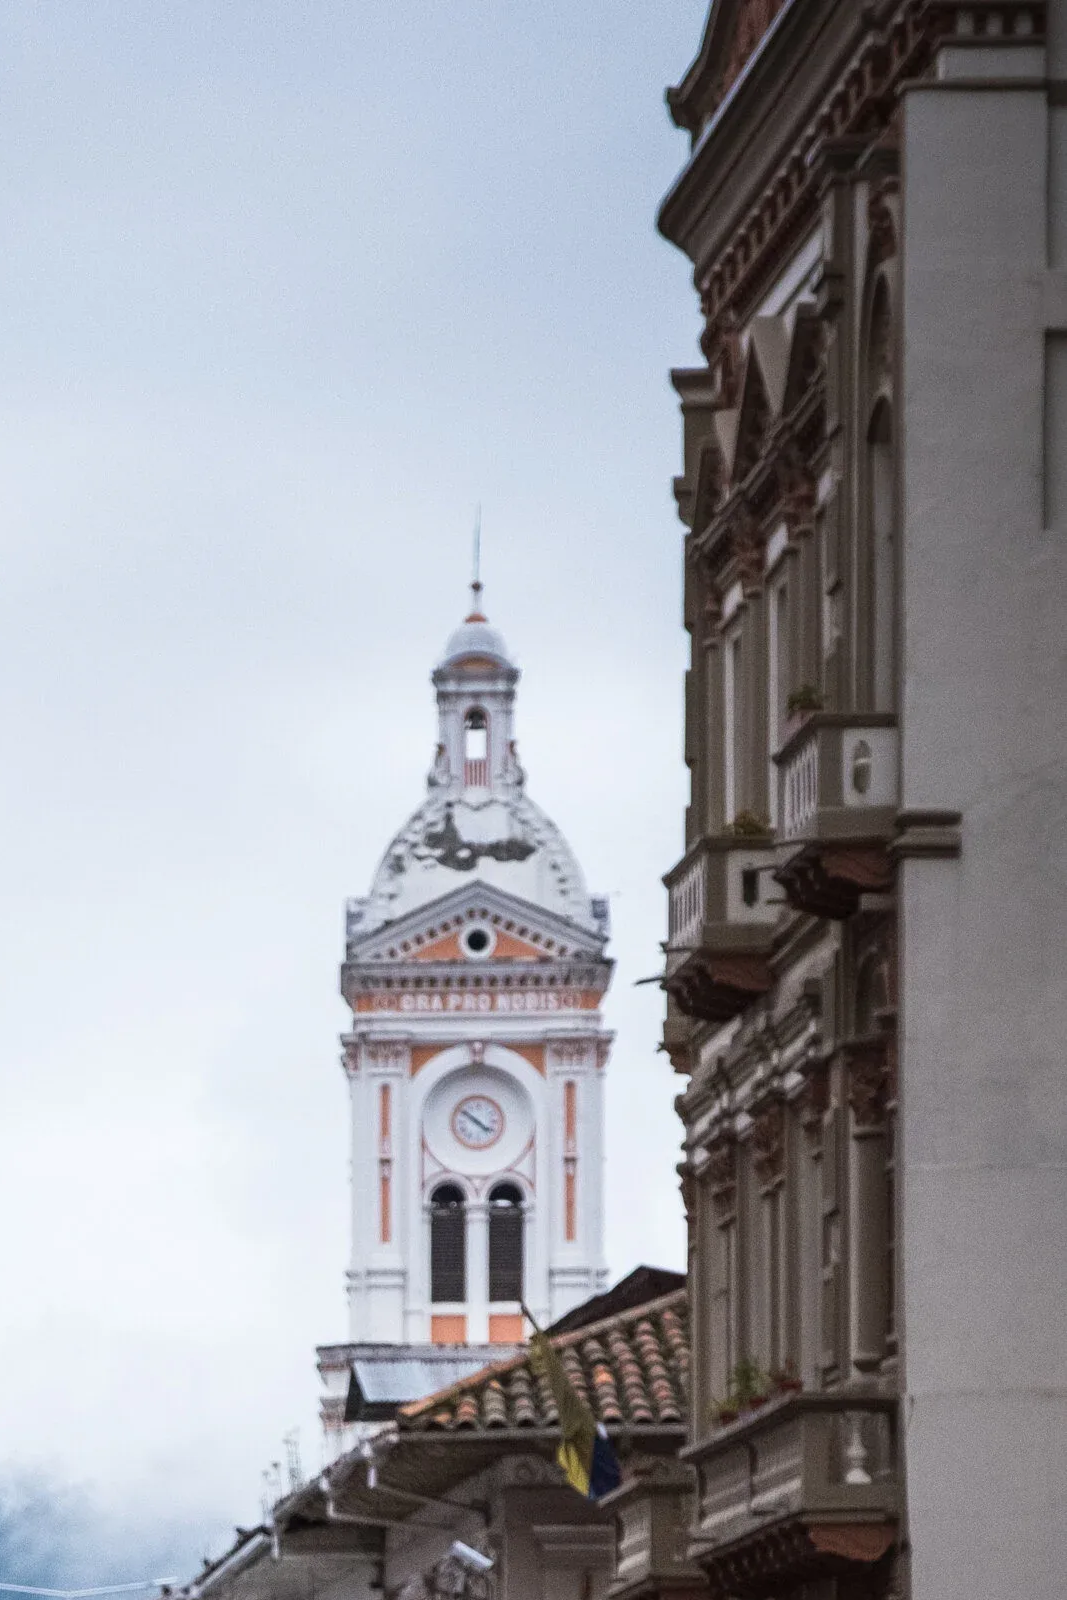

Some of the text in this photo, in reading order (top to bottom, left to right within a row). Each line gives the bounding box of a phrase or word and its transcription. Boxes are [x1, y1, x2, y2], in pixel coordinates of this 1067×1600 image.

[399, 992, 559, 1010] ORA PRO NOBIS
